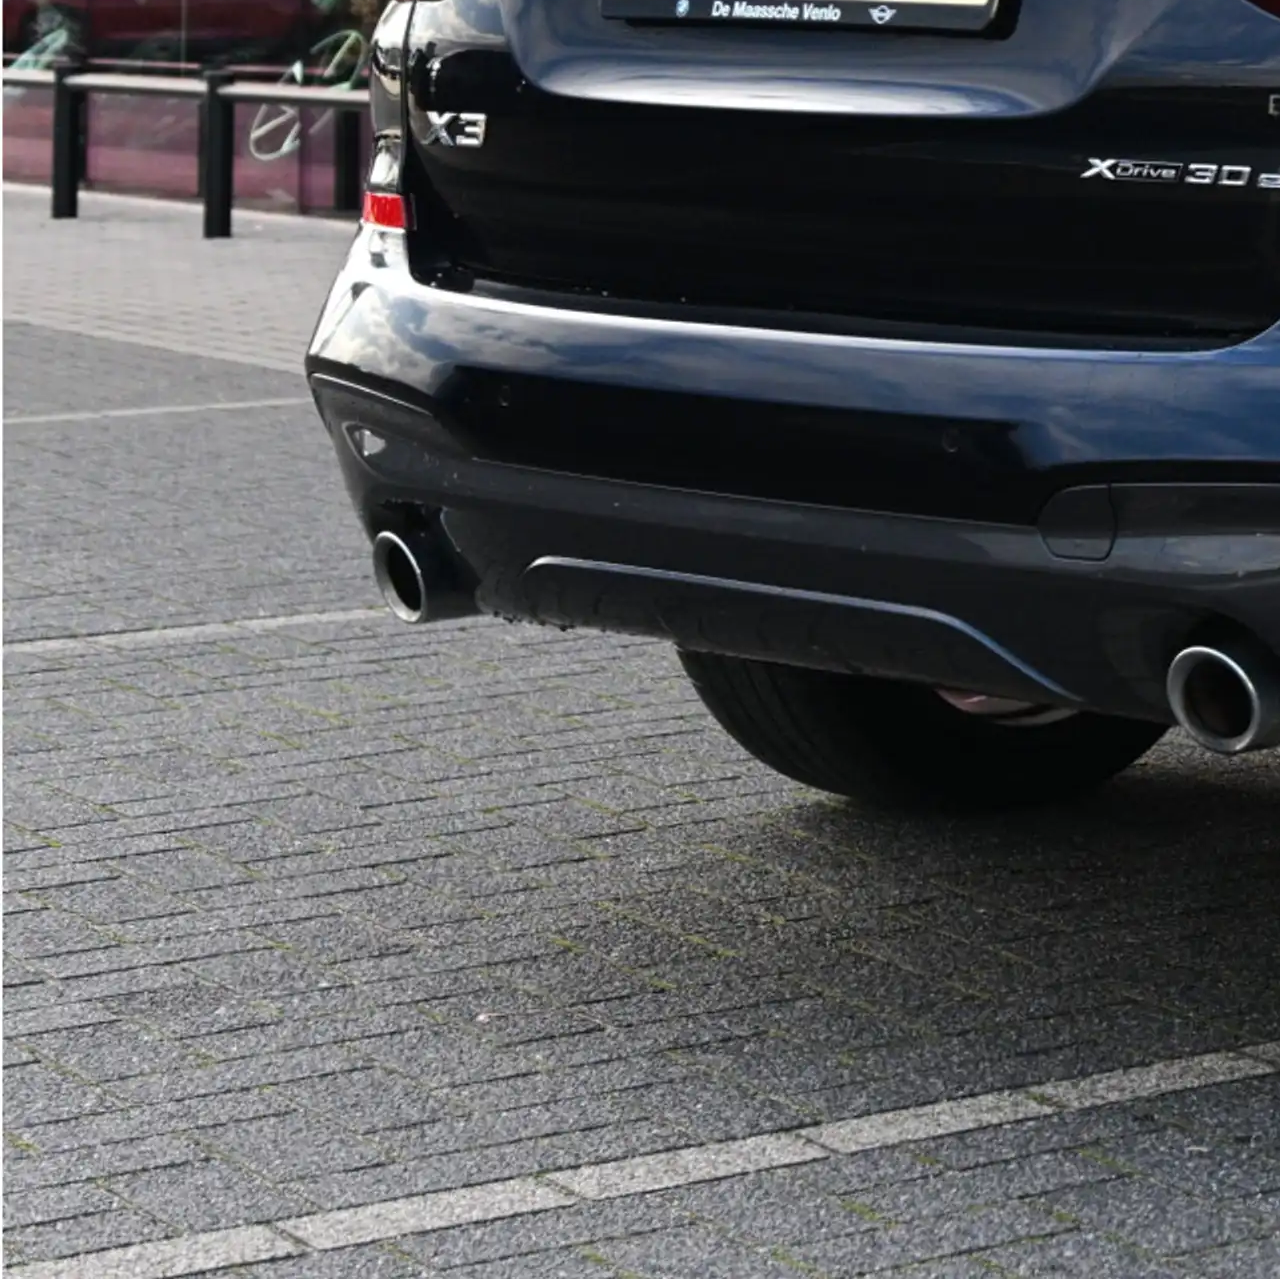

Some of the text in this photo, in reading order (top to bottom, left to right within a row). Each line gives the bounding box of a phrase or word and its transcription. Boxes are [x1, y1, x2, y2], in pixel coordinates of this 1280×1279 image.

[711, 1, 842, 21] De Maassche Venlo
[420, 110, 487, 148] X3
